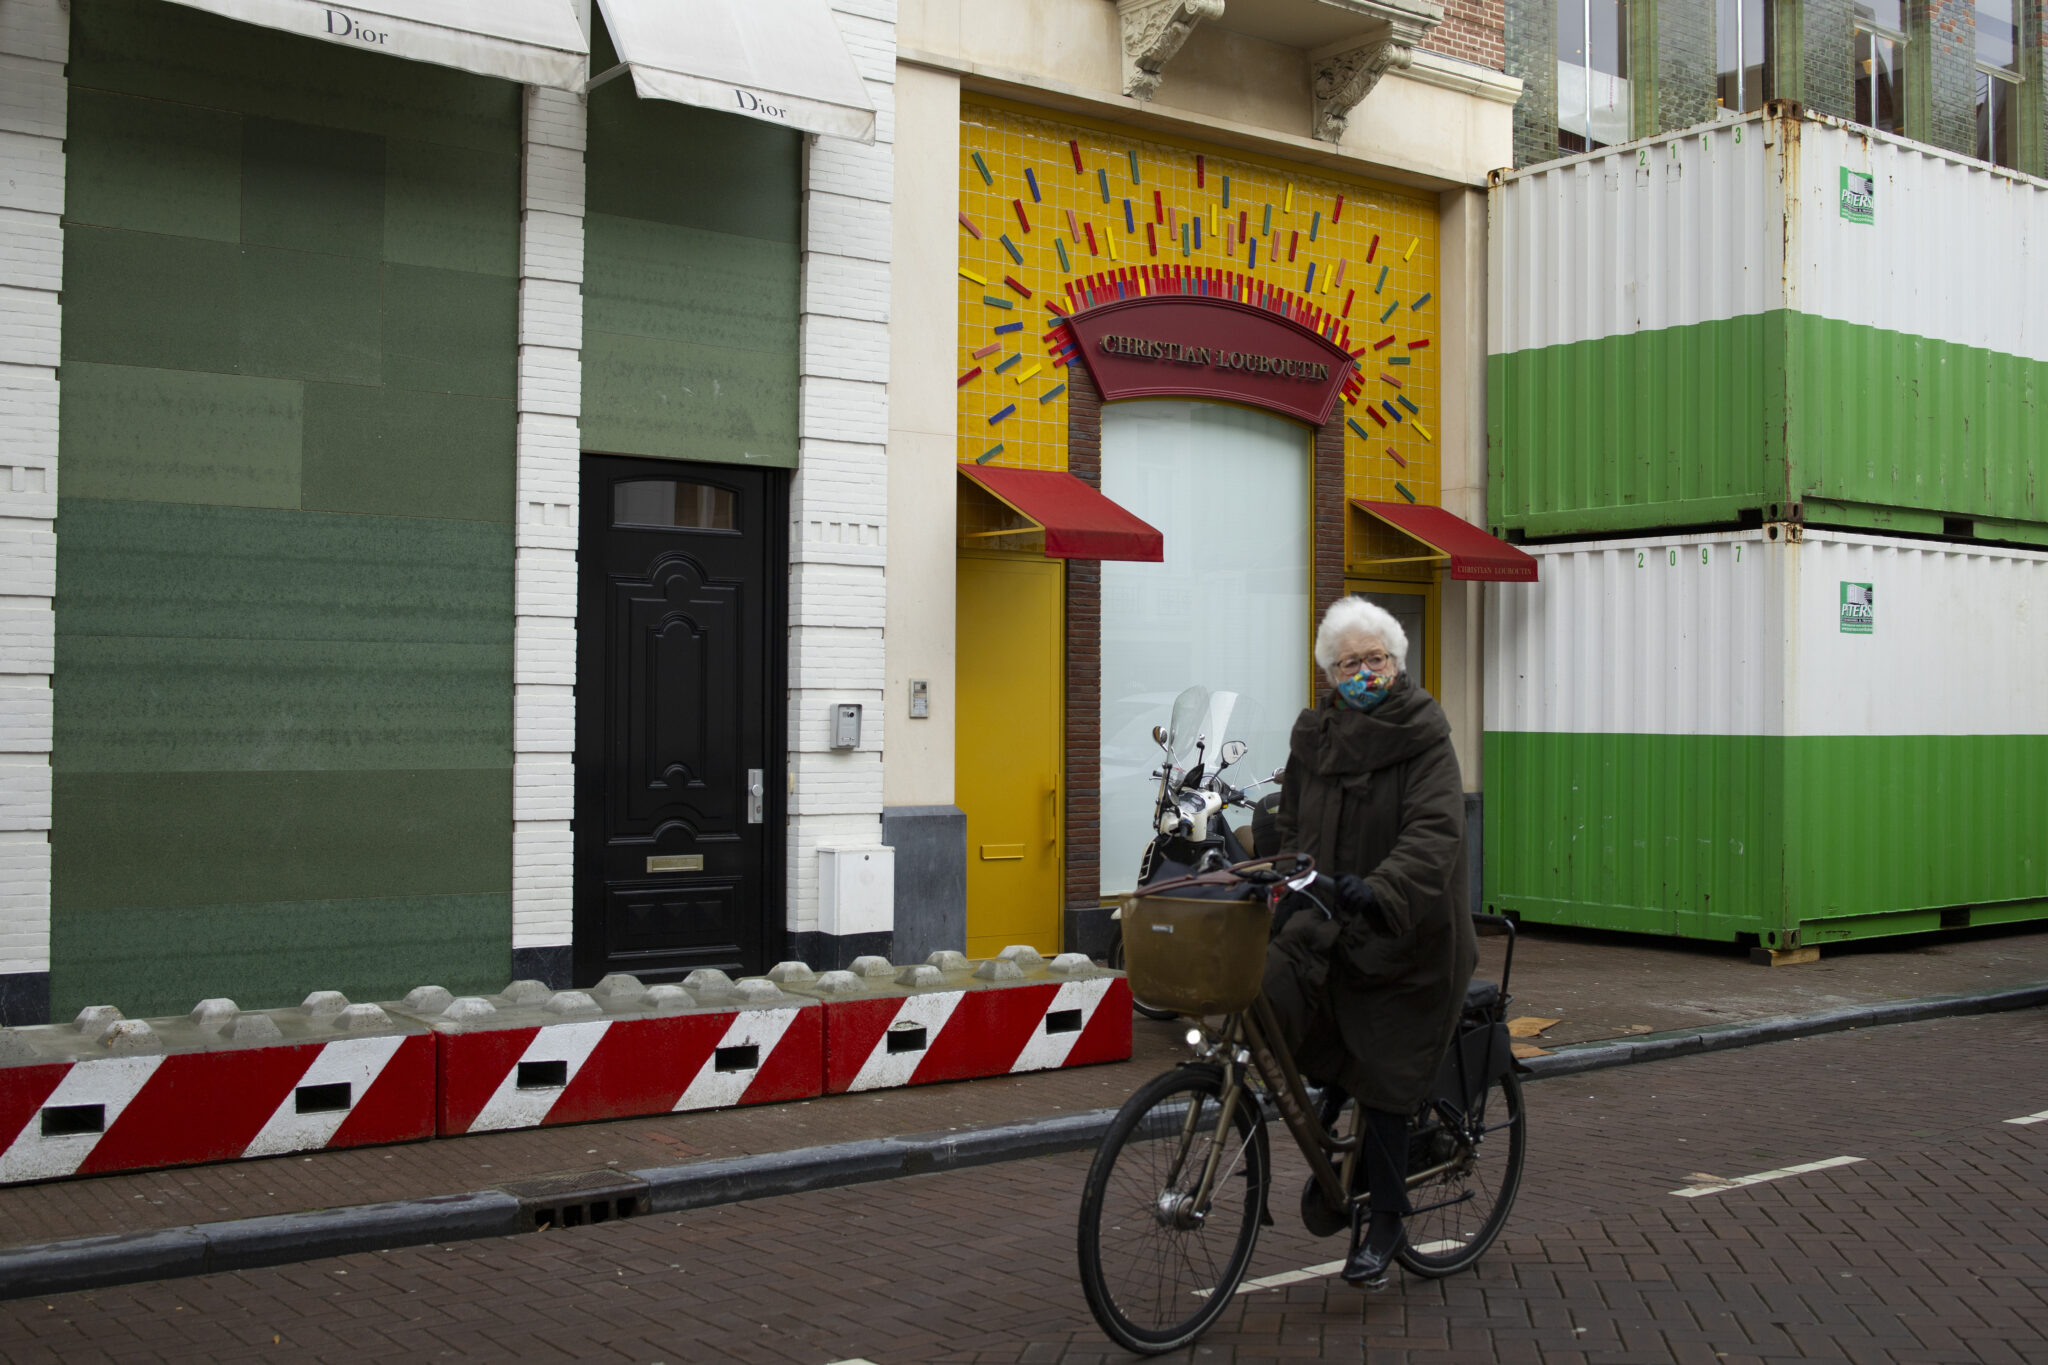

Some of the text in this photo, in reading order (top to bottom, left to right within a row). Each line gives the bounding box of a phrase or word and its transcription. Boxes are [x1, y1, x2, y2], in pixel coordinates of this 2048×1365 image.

[323, 9, 388, 44] Dior
[734, 89, 786, 118] Dior
[1100, 334, 1329, 380] CHRISTIAN LOUBOUTIN
[1457, 565, 1532, 576] CHRISTIAN LOUBOUTIN
